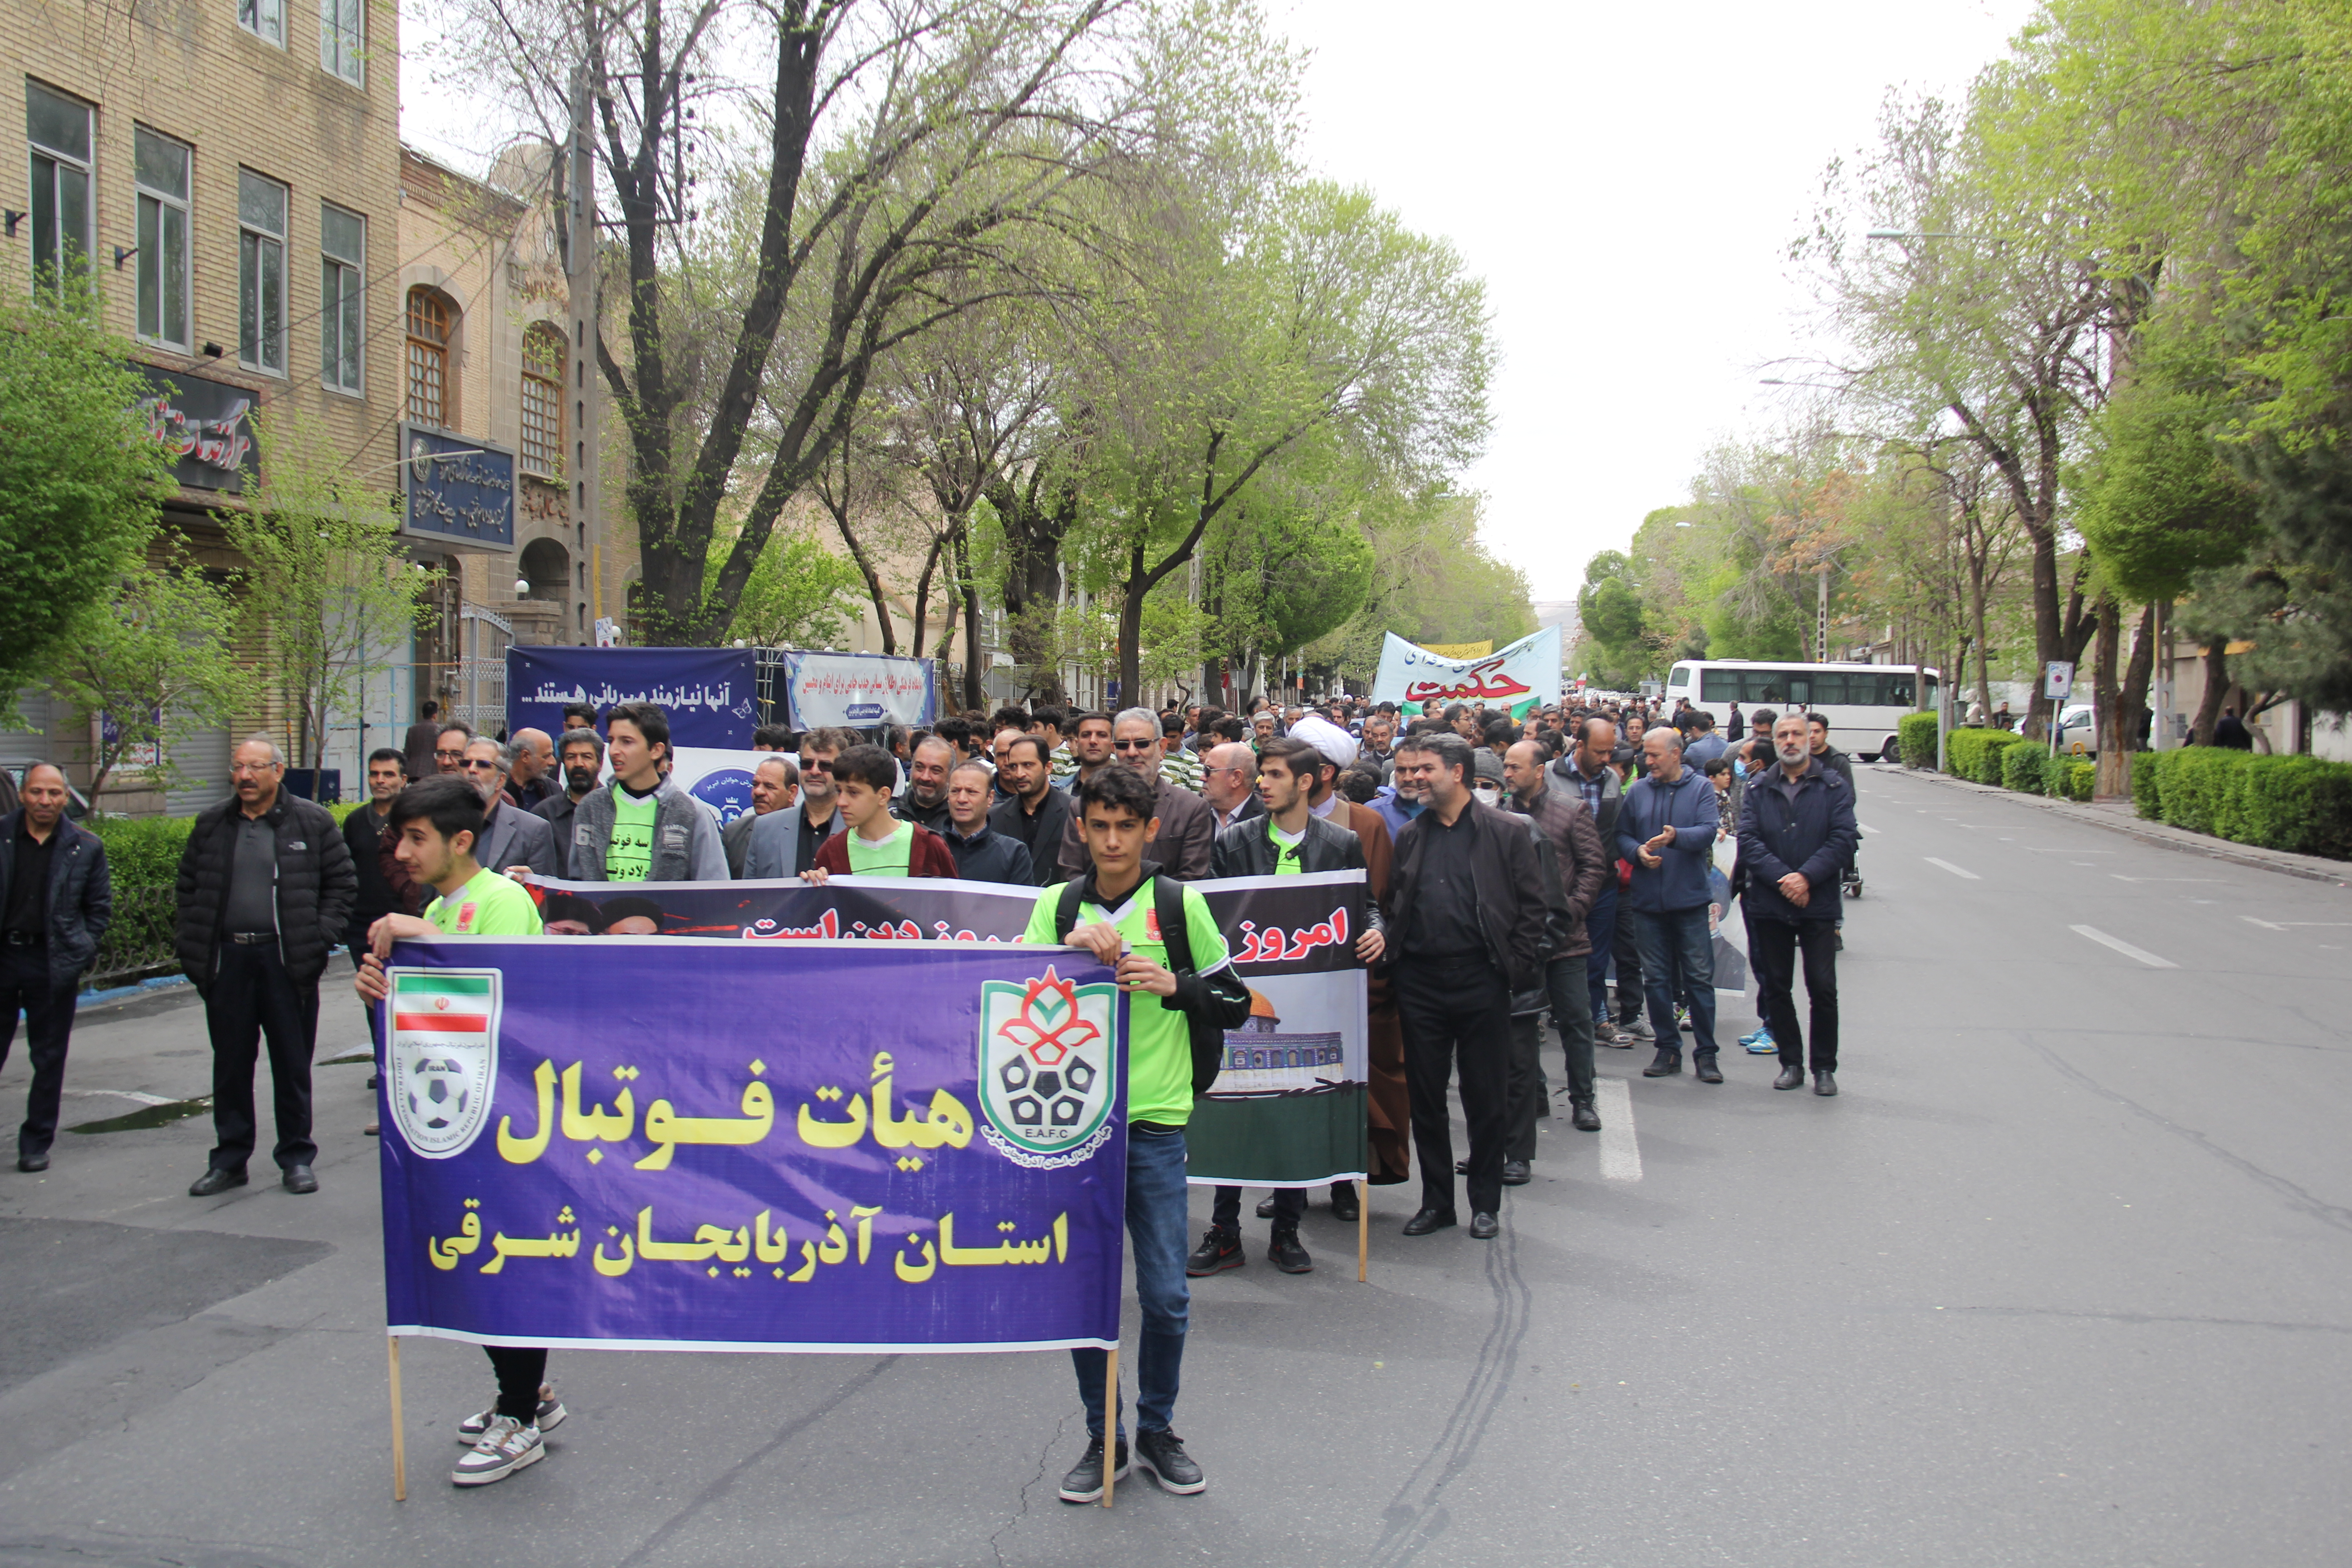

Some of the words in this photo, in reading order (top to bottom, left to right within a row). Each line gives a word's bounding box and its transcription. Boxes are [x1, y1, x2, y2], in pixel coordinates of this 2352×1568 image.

[534, 682, 587, 703] هستند
[833, 672, 844, 695] برای
[1406, 659, 1531, 702] حکمت
[649, 683, 702, 712] نیازمند
[704, 681, 731, 712] آنها
[610, 833, 631, 849] فوتب
[628, 865, 650, 880] ولاد
[1231, 906, 1348, 963] امروز
[396, 1057, 404, 1102] FOOTBALL
[476, 1059, 487, 1079] IRAN
[475, 1082, 484, 1093] OF
[460, 1095, 480, 1133] REPUBLIC
[497, 1058, 776, 1171] فوتبال
[797, 1051, 974, 1172] هیأت
[430, 1130, 460, 1143] ISLAMIC
[1025, 1128, 1068, 1138] E.A.F.C
[1002, 1147, 1043, 1166] آذربایجان
[1044, 1156, 1067, 1167] استان
[1069, 1144, 1093, 1165] فوتبال
[428, 1198, 581, 1276] شرقی
[593, 1206, 883, 1283] آذربایجان
[894, 1210, 1068, 1282] استان
